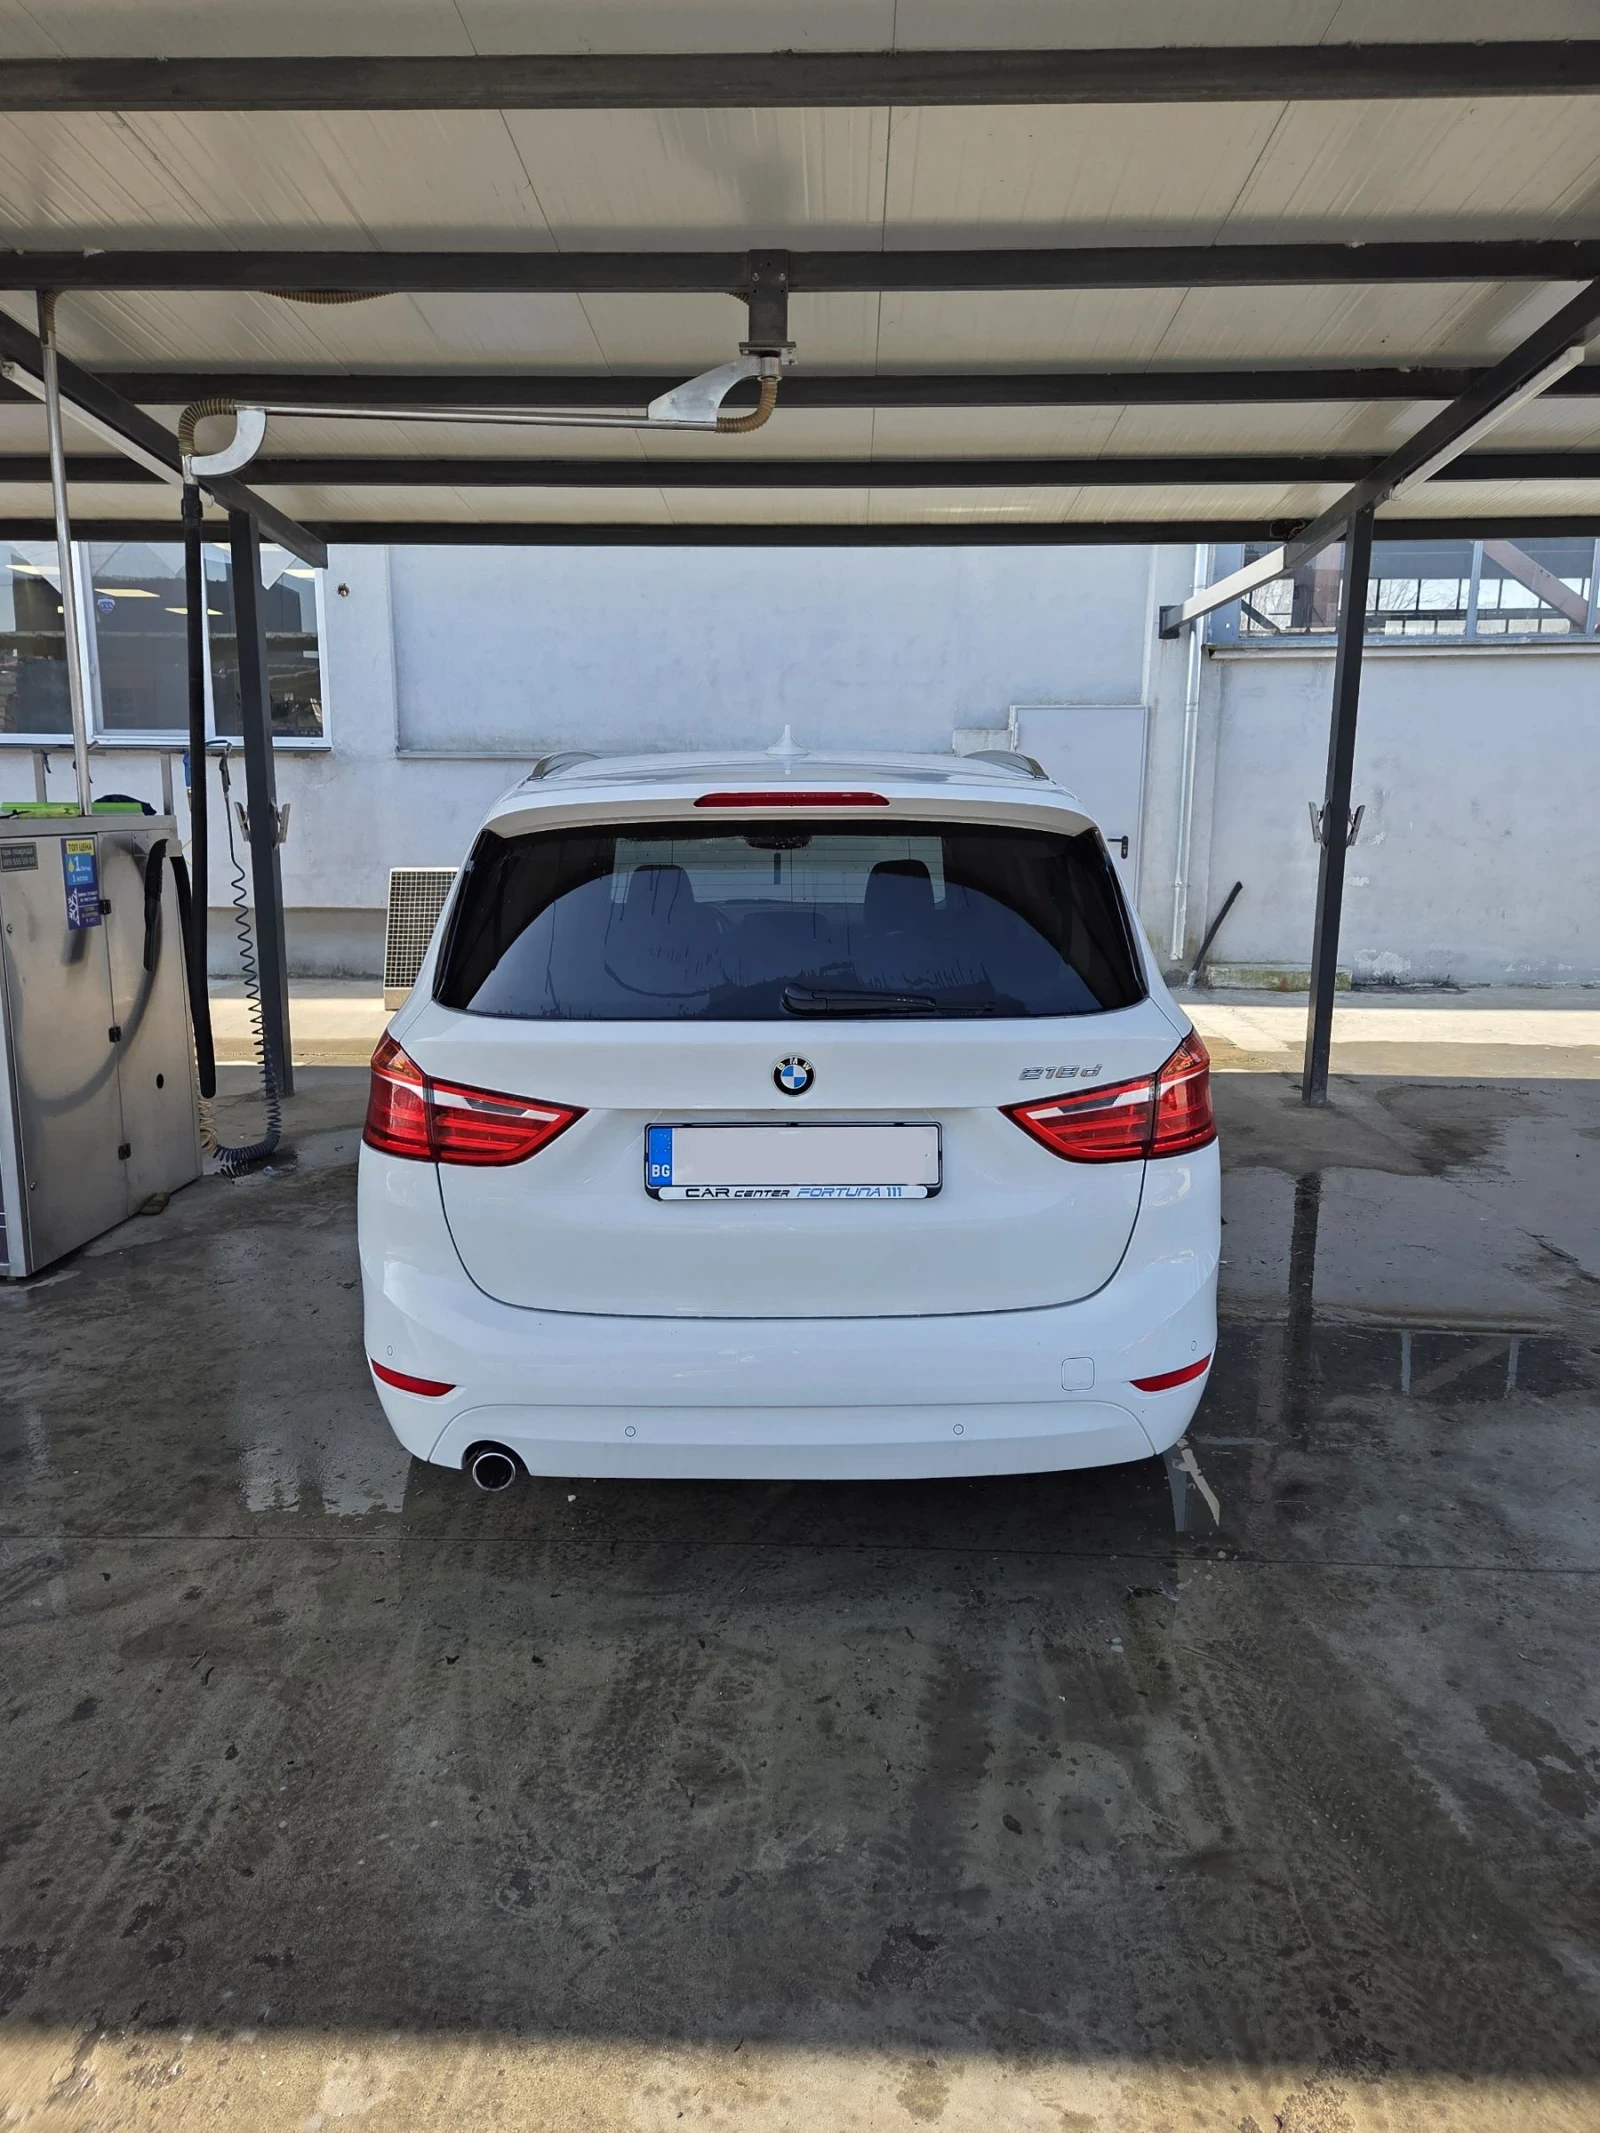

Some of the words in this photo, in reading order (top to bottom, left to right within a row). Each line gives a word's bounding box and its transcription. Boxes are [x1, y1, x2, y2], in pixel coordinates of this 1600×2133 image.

[68, 843, 78, 852] ТОП
[79, 842, 92, 852] ЦЕНА
[776, 1057, 812, 1071] BMW
[651, 1164, 671, 1178] BG
[685, 1188, 730, 1198] CAR
[797, 1187, 881, 1198] FORTUNA
[886, 1187, 902, 1197] 111
